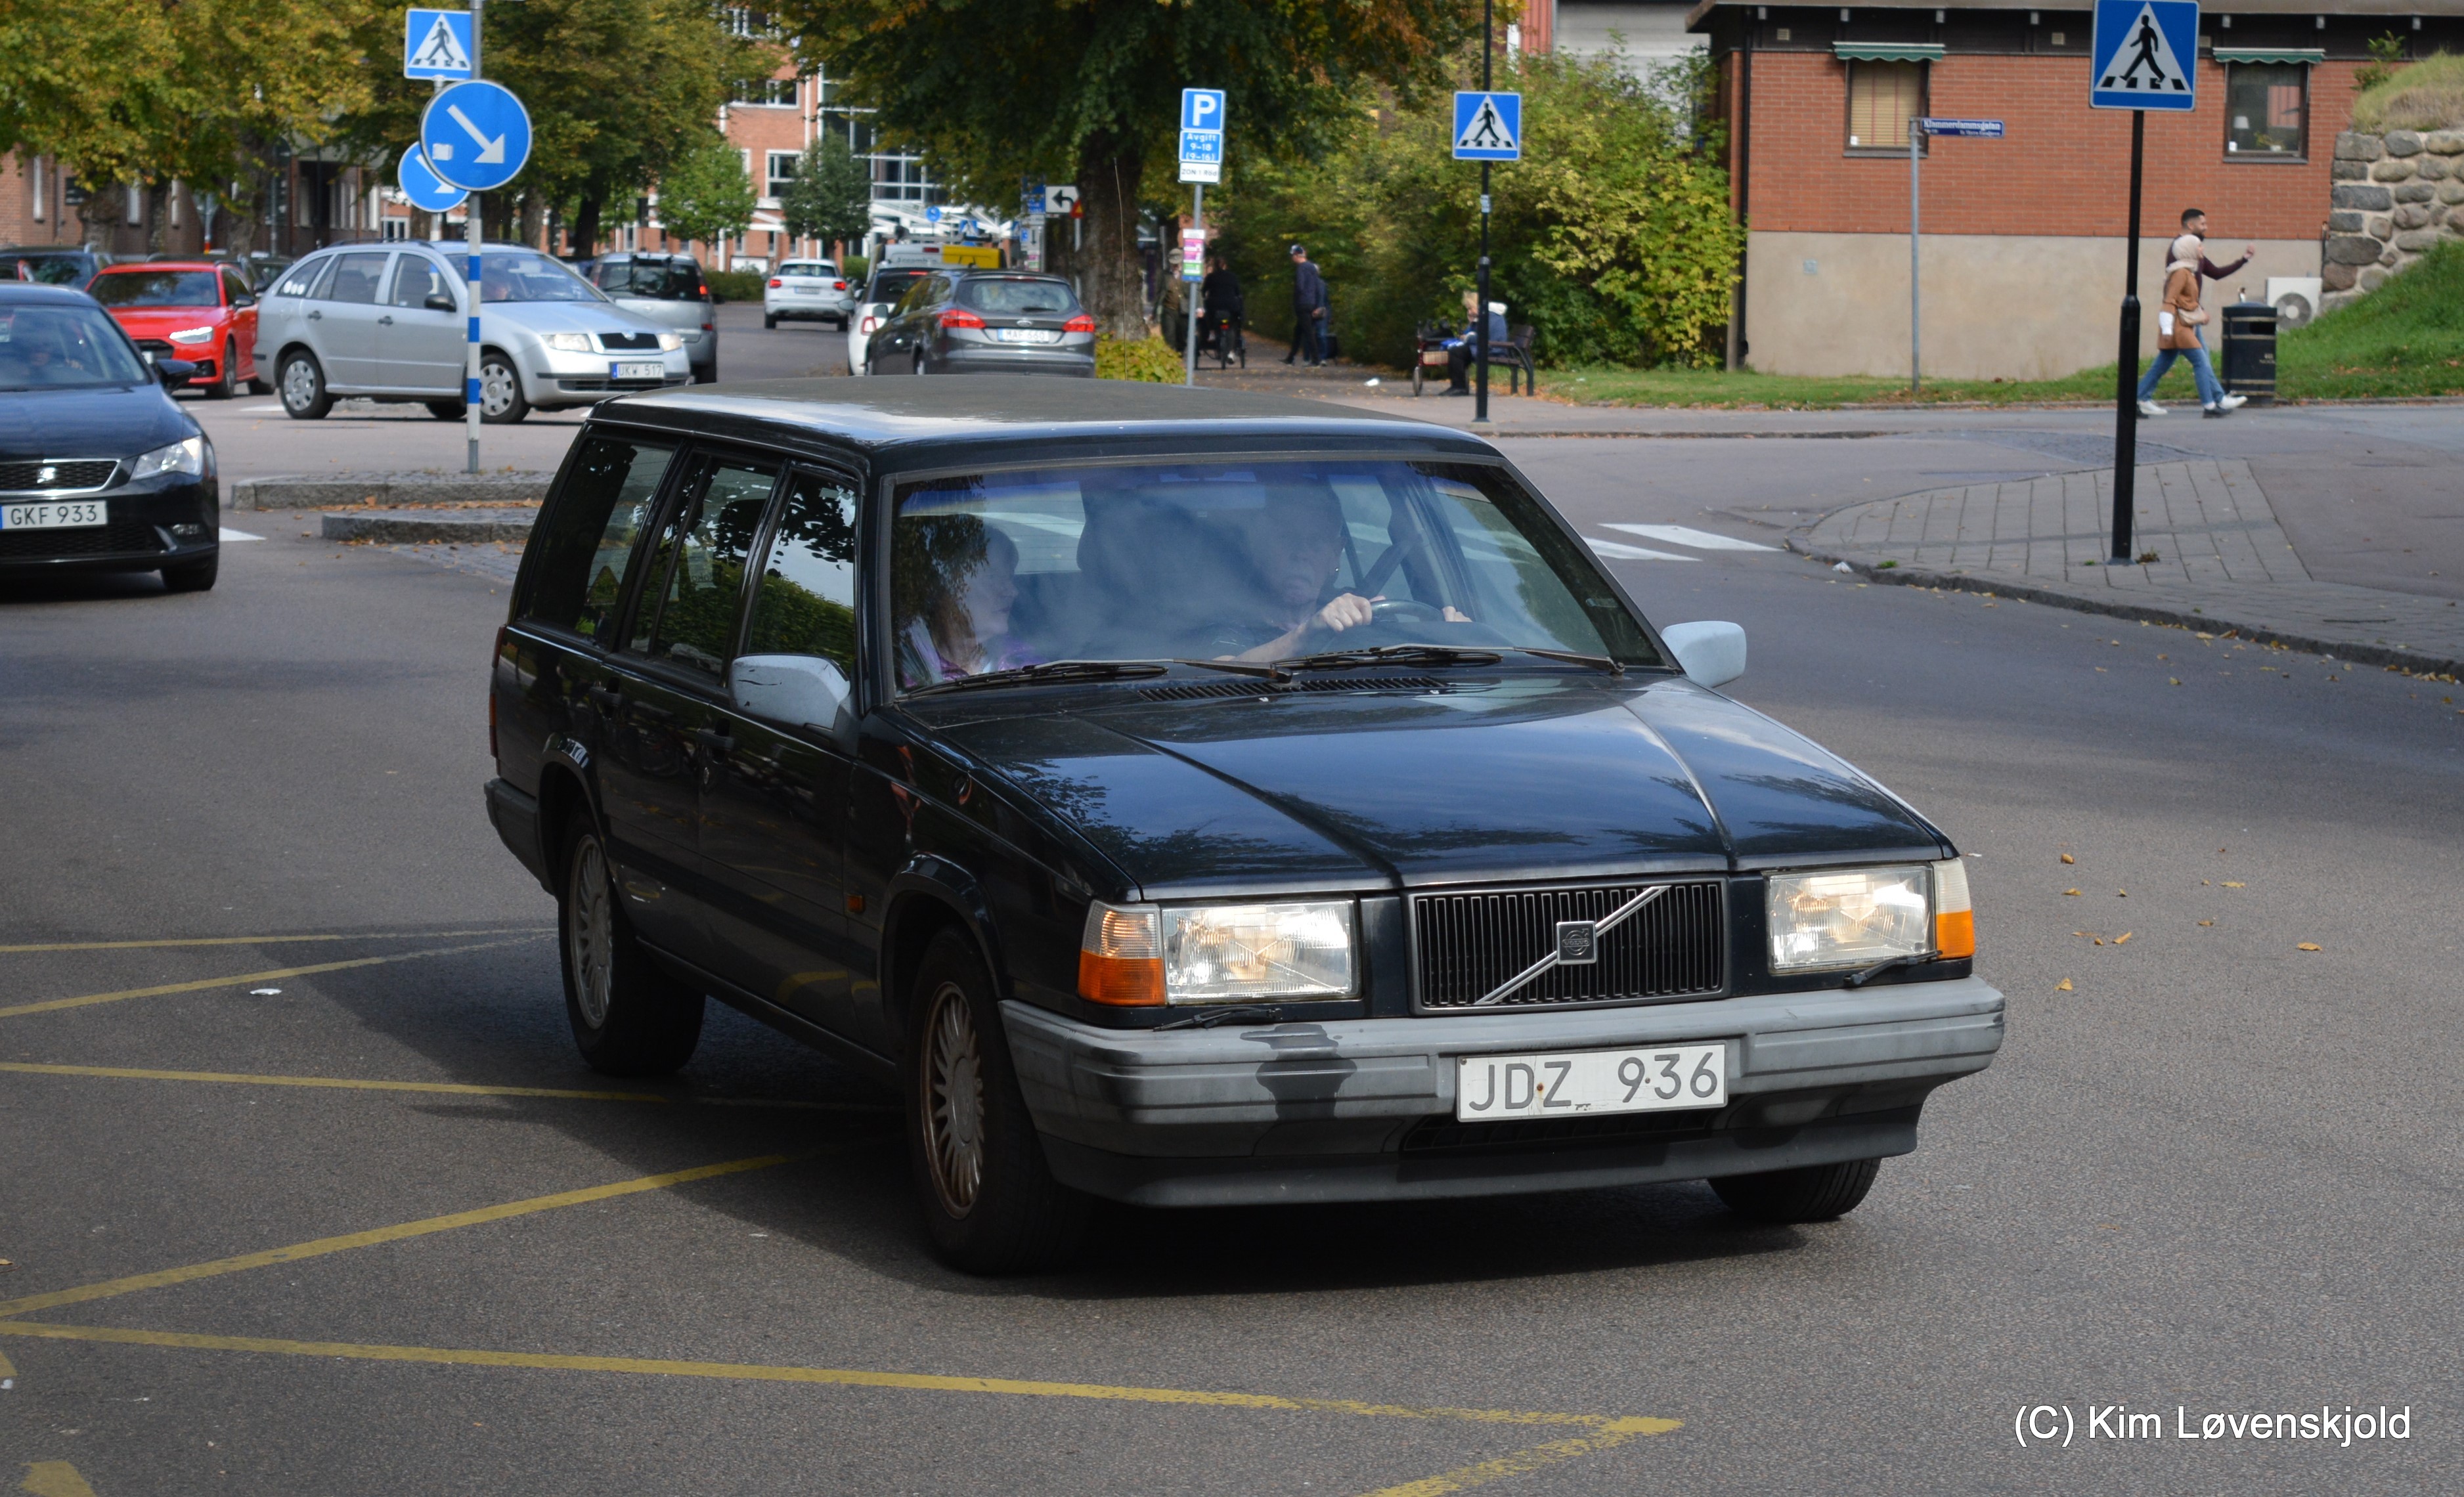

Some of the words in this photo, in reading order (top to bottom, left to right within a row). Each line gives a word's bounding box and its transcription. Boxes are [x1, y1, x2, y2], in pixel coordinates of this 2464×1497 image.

[1192, 93, 1217, 127] P
[1186, 133, 1216, 142] Avgift
[645, 364, 662, 376] 517
[11, 506, 49, 525] GKF
[57, 504, 97, 524] 933
[1468, 1060, 1572, 1112] JDZ
[1617, 1051, 1718, 1103] 936
